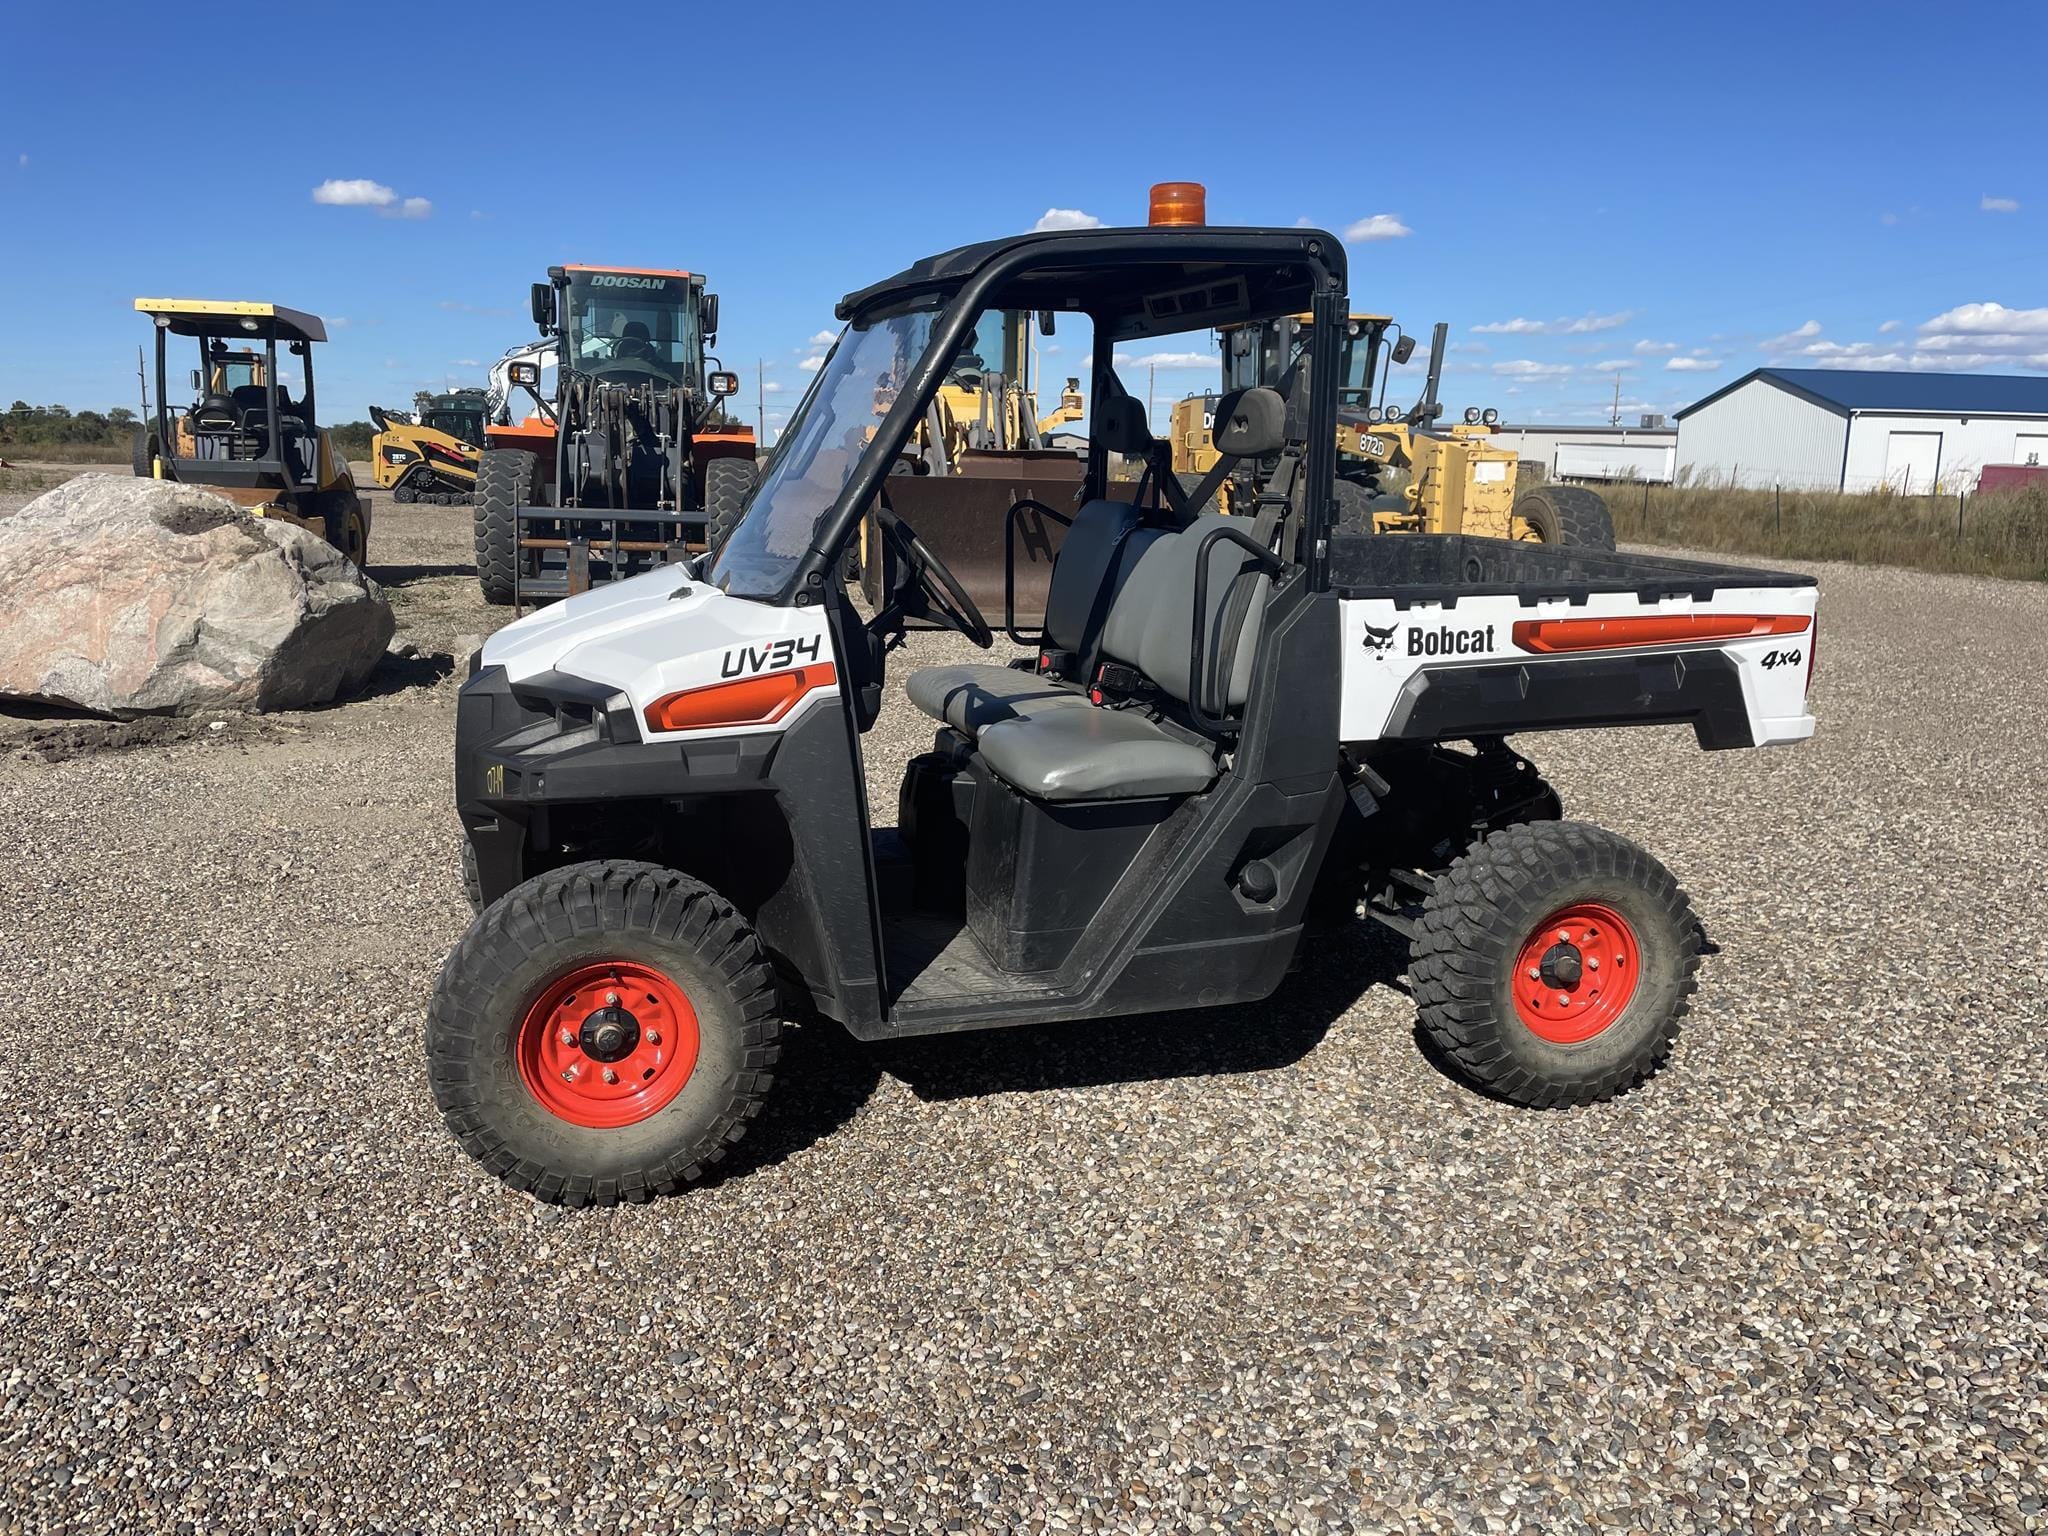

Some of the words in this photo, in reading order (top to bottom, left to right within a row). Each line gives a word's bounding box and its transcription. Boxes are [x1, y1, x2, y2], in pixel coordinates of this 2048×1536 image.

[590, 275, 666, 290] DOOSAN
[1360, 433, 1385, 456] 872D
[1407, 624, 1495, 657] Bobcat
[721, 633, 822, 679] UV34
[1760, 648, 1802, 670] 4x4
